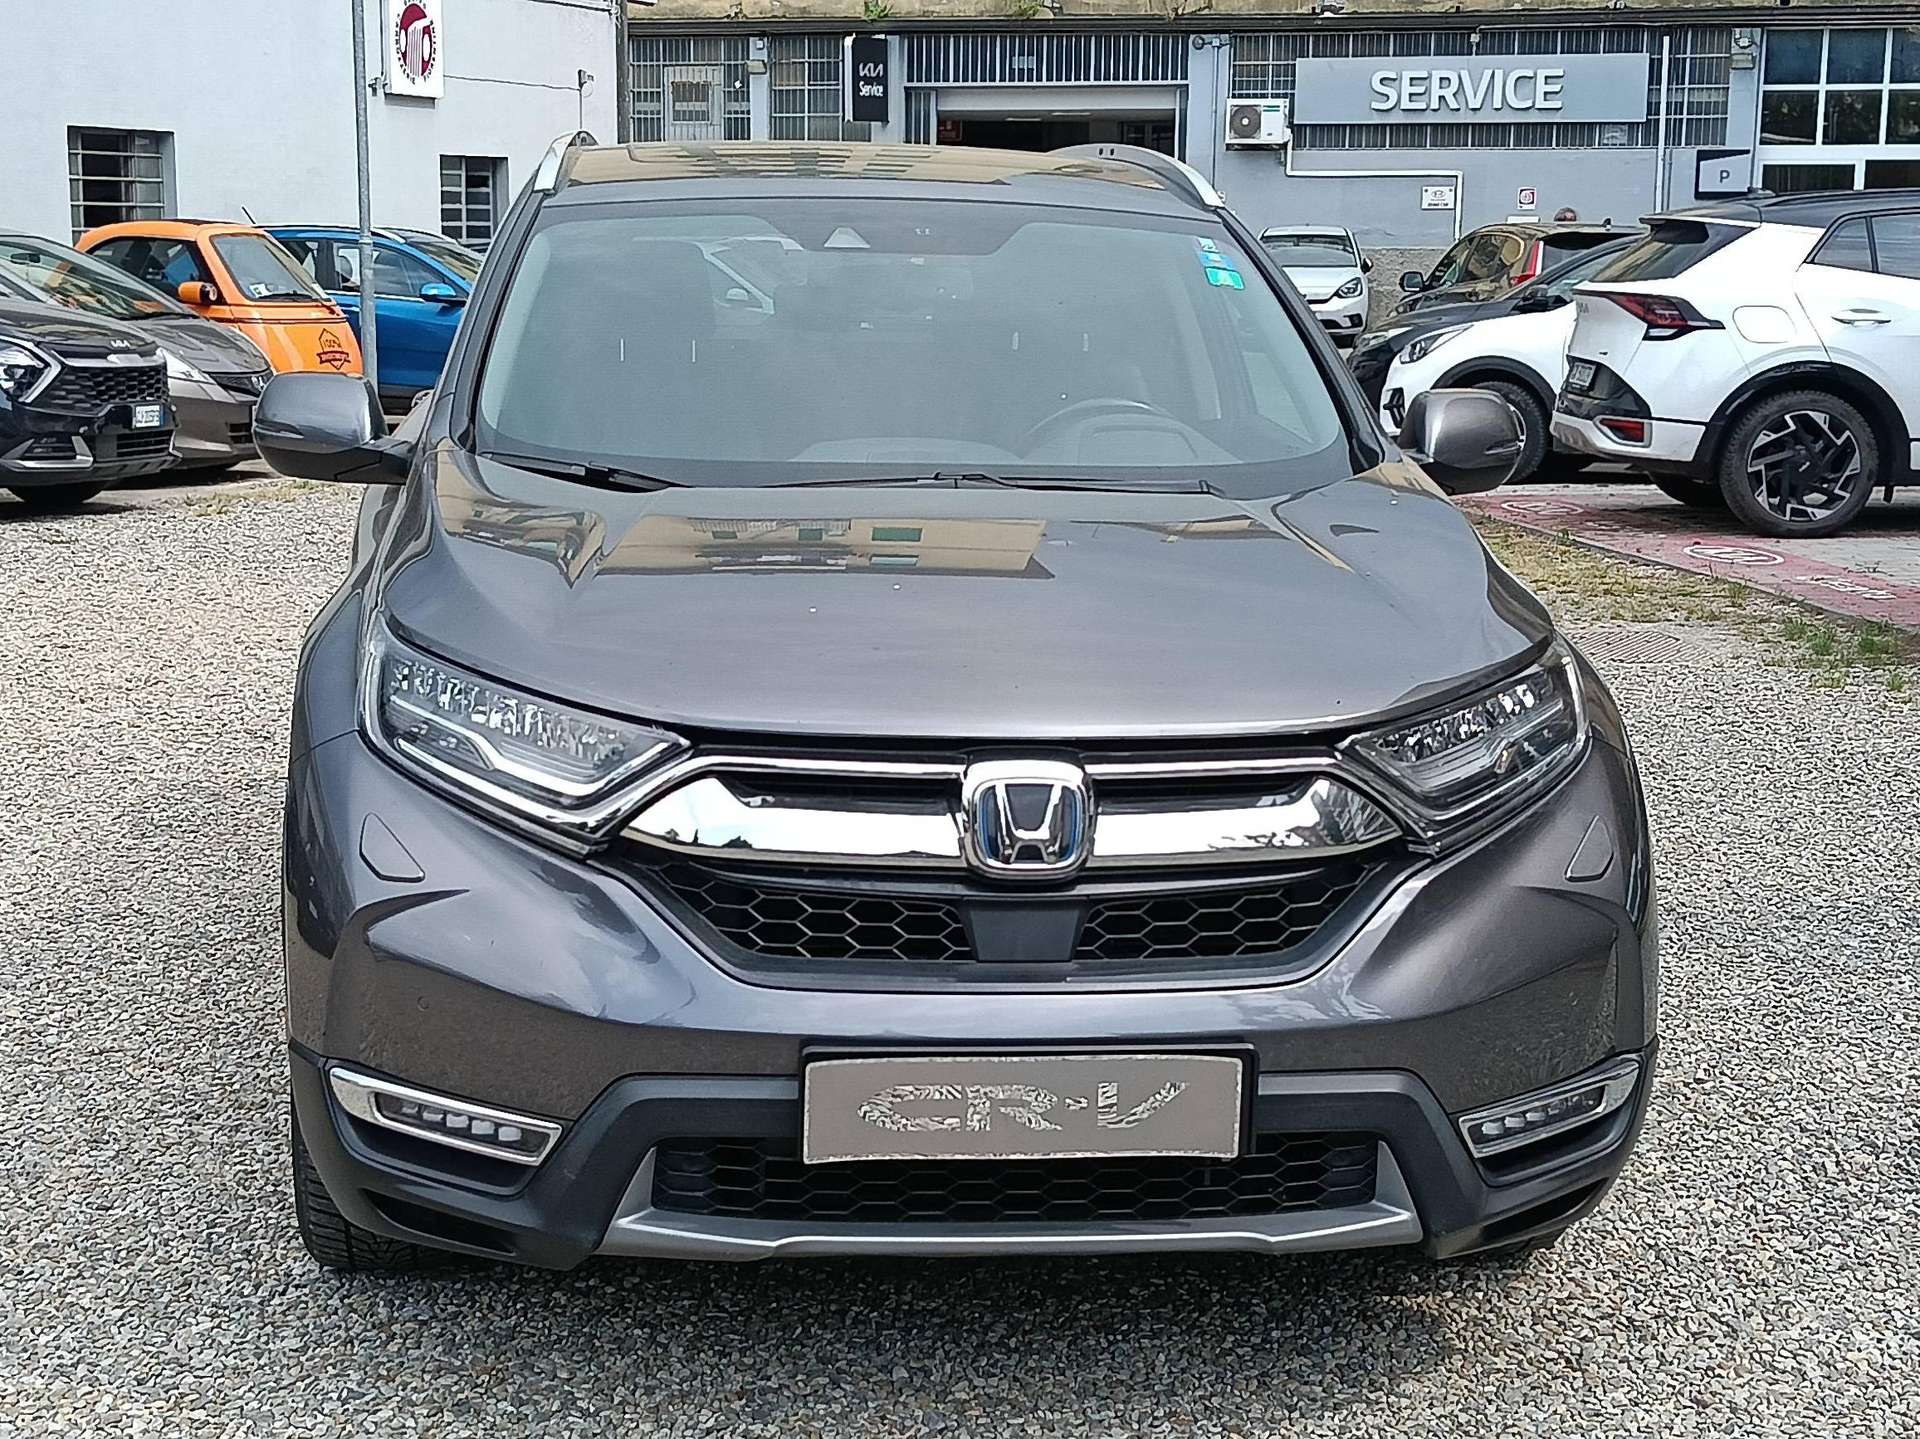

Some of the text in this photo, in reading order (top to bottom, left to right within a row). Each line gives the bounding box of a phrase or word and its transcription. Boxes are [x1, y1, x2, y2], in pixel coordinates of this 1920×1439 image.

[858, 80, 884, 97] Service
[1369, 68, 1565, 112] SERVICE
[1719, 169, 1731, 184] P
